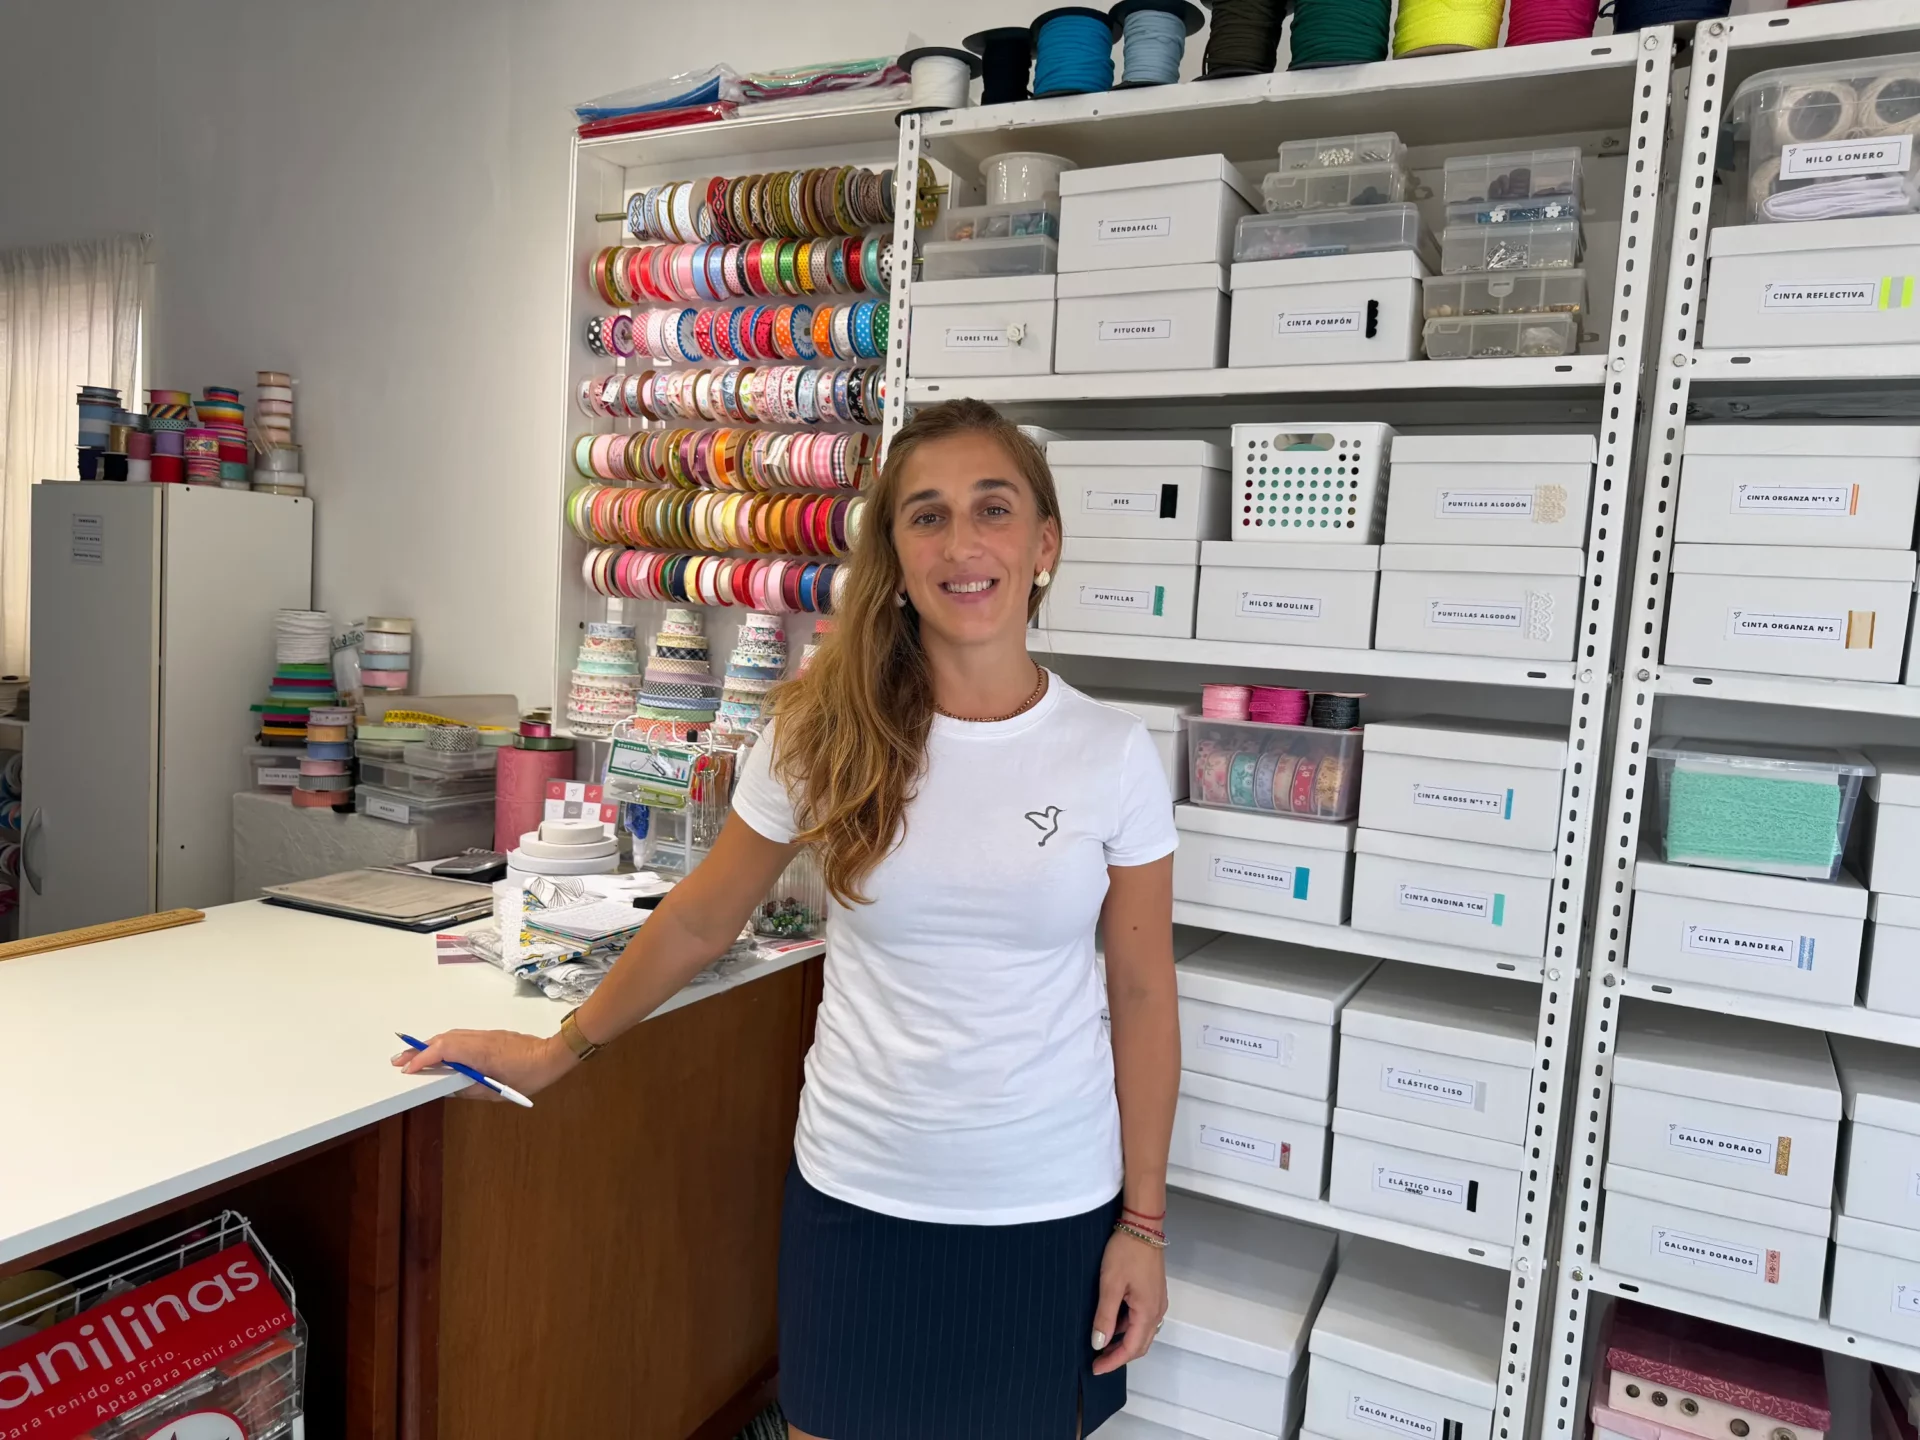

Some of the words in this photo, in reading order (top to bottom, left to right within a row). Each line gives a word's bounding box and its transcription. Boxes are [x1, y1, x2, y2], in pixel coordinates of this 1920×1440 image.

[1805, 155, 1833, 164] HILO
[1837, 151, 1884, 162] LONERO
[1110, 224, 1158, 233] MENDAFACIL
[1773, 292, 1803, 300] CINTA
[1806, 291, 1865, 299] REFLECTIVA
[1286, 319, 1312, 327] CINTA
[1315, 317, 1352, 325] POMPÓN
[1113, 326, 1156, 334] PITUCONES
[1094, 594, 1134, 602] PUNTILLAS
[1248, 600, 1273, 608] HILOS
[1275, 602, 1314, 611] MOULINE
[1479, 612, 1517, 620] ALGODÓN
[1741, 621, 1769, 629] CINTA
[1771, 623, 1815, 632] ORGANZA
[1417, 792, 1441, 800] CINTA
[1442, 795, 1468, 803] GROSS
[1222, 867, 1242, 875] CINTA
[1243, 871, 1265, 879] GROSS
[1404, 893, 1429, 902] CINTA
[1431, 897, 1464, 908] ONDINA
[1466, 902, 1484, 911] 1CM
[1698, 935, 1730, 945] CINTA
[1734, 939, 1785, 952] BANDERA
[1219, 1035, 1262, 1049] PUNTILLAS
[1397, 1077, 1439, 1091] ELÁSTICO
[1442, 1086, 1463, 1096] LISO
[1219, 1136, 1255, 1150] GALONES
[1678, 1134, 1714, 1146] GALON
[1718, 1141, 1762, 1155] DORADO
[1388, 1177, 1430, 1191] ELÁSTICO
[1432, 1186, 1453, 1196] LISO
[1664, 1241, 1706, 1255] GALONES
[1709, 1250, 1753, 1266] DORADOS
[0, 1260, 260, 1410] anilinas
[96, 1390, 138, 1417] Apta
[141, 1368, 180, 1396] para
[228, 1334, 244, 1349] al
[245, 1312, 288, 1339] Calor
[114, 1370, 136, 1386] en
[1358, 1404, 1387, 1418] GALÓN
[1389, 1414, 1432, 1432] PLATEADO
